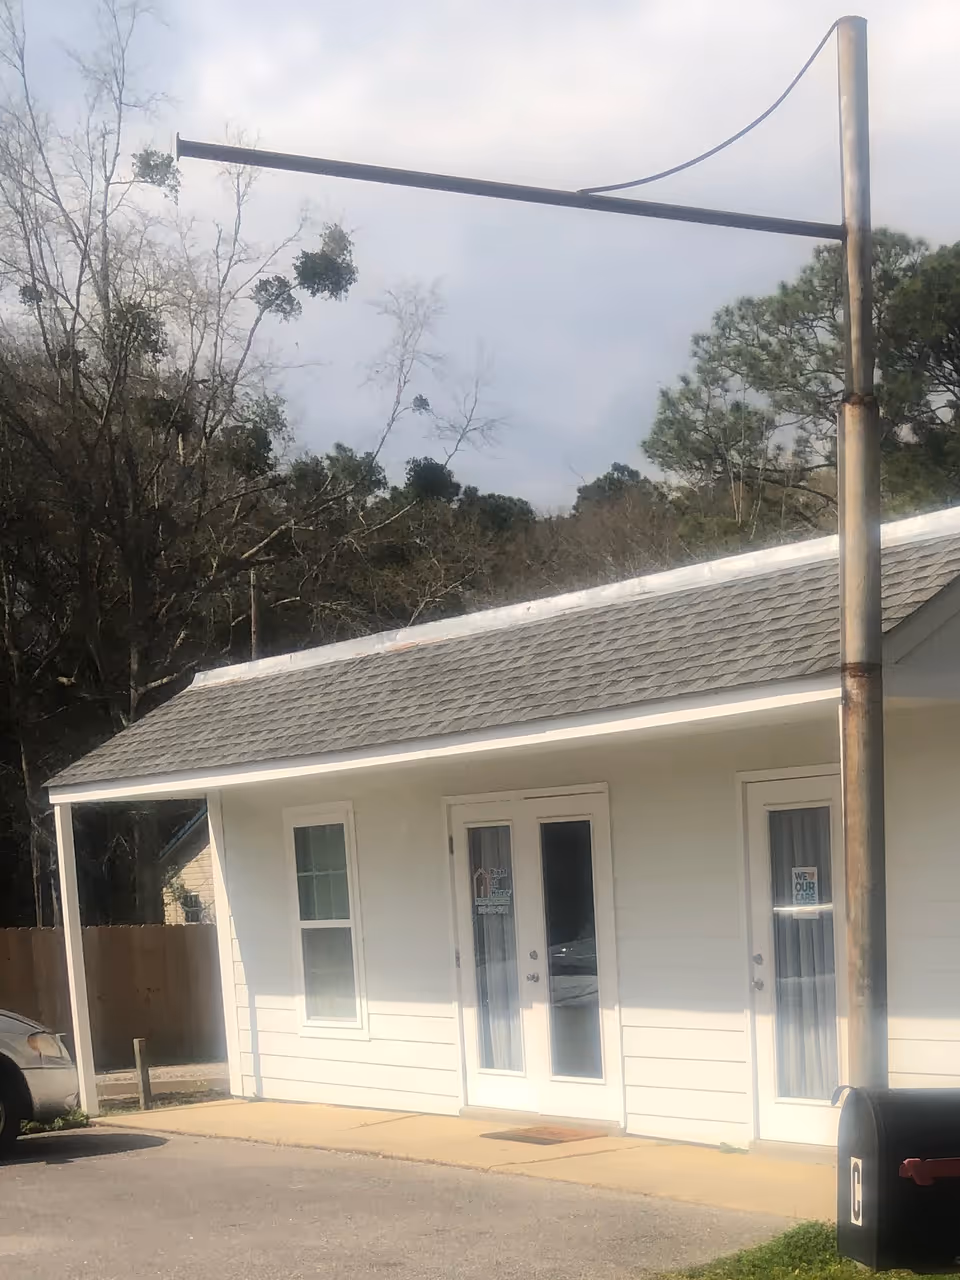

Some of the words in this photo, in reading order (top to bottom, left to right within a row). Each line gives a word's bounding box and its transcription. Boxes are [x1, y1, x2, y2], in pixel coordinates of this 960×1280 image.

[794, 871, 808, 881] WE
[795, 881, 815, 893] OUR
[795, 893, 816, 902] CARE
[852, 1161, 861, 1222] C
